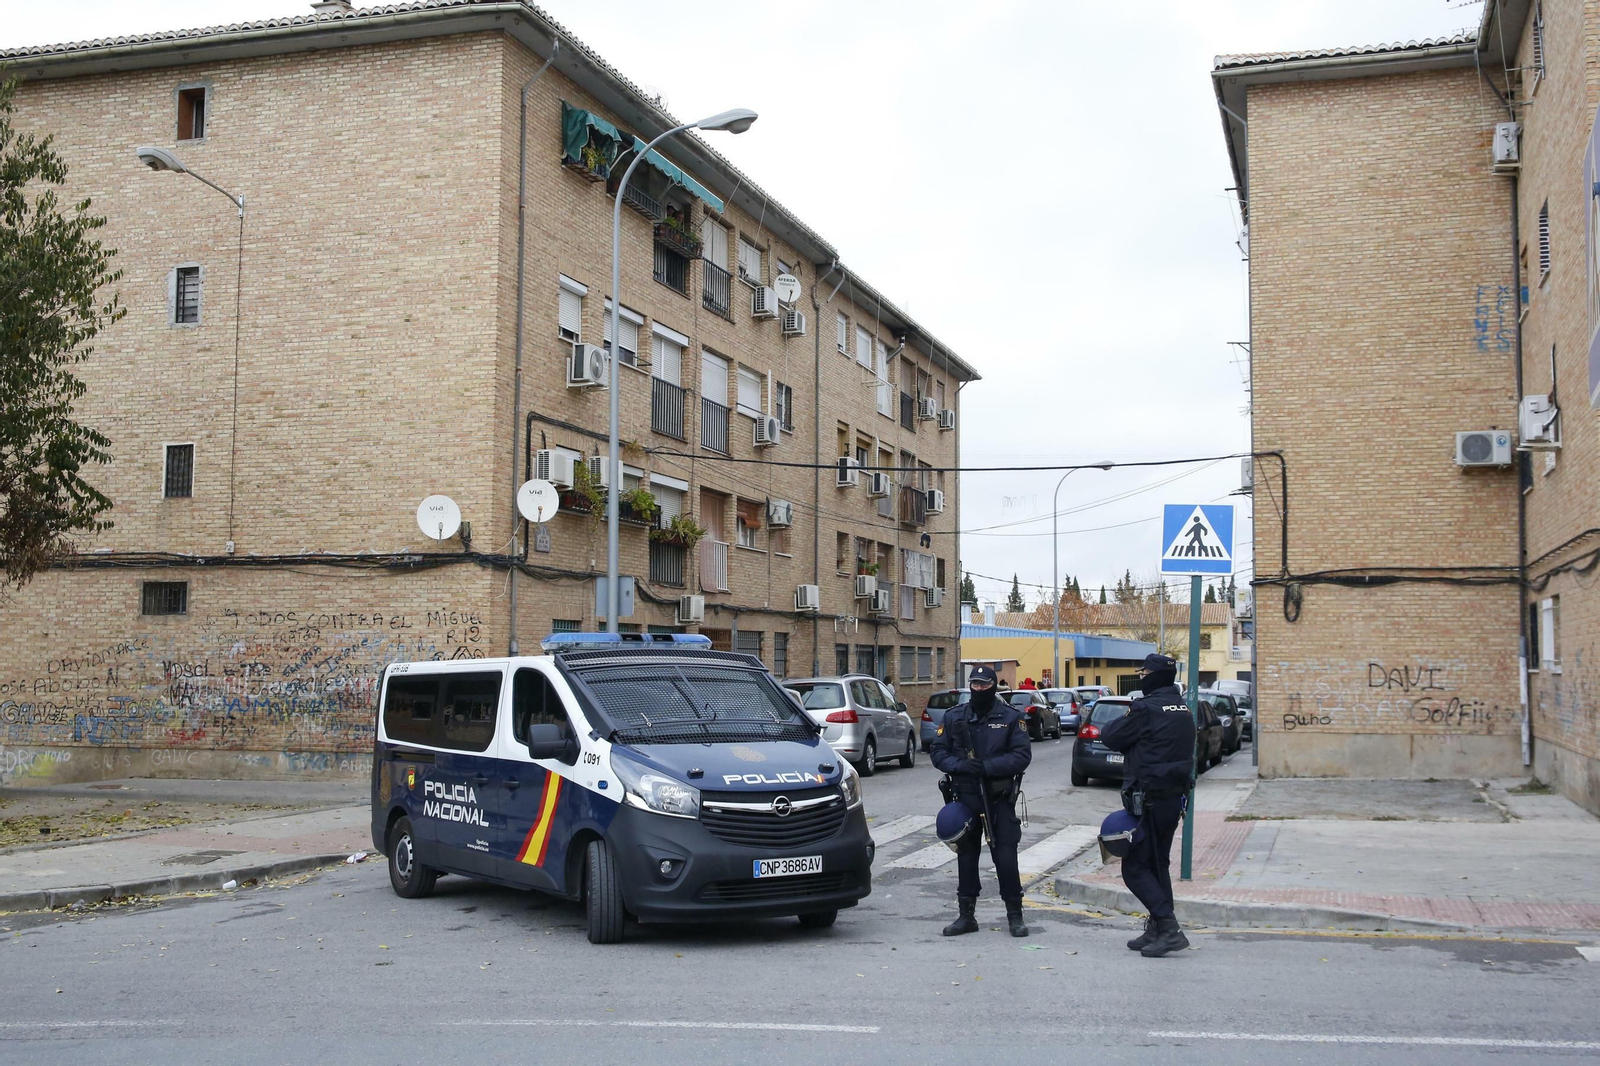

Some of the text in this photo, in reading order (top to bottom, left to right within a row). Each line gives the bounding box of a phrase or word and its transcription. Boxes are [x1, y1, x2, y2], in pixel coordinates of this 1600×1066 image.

[587, 752, 601, 766] 091
[722, 770, 818, 785] POLICÍA
[424, 780, 477, 804] POLICÍA
[423, 799, 490, 828] NACIONAL
